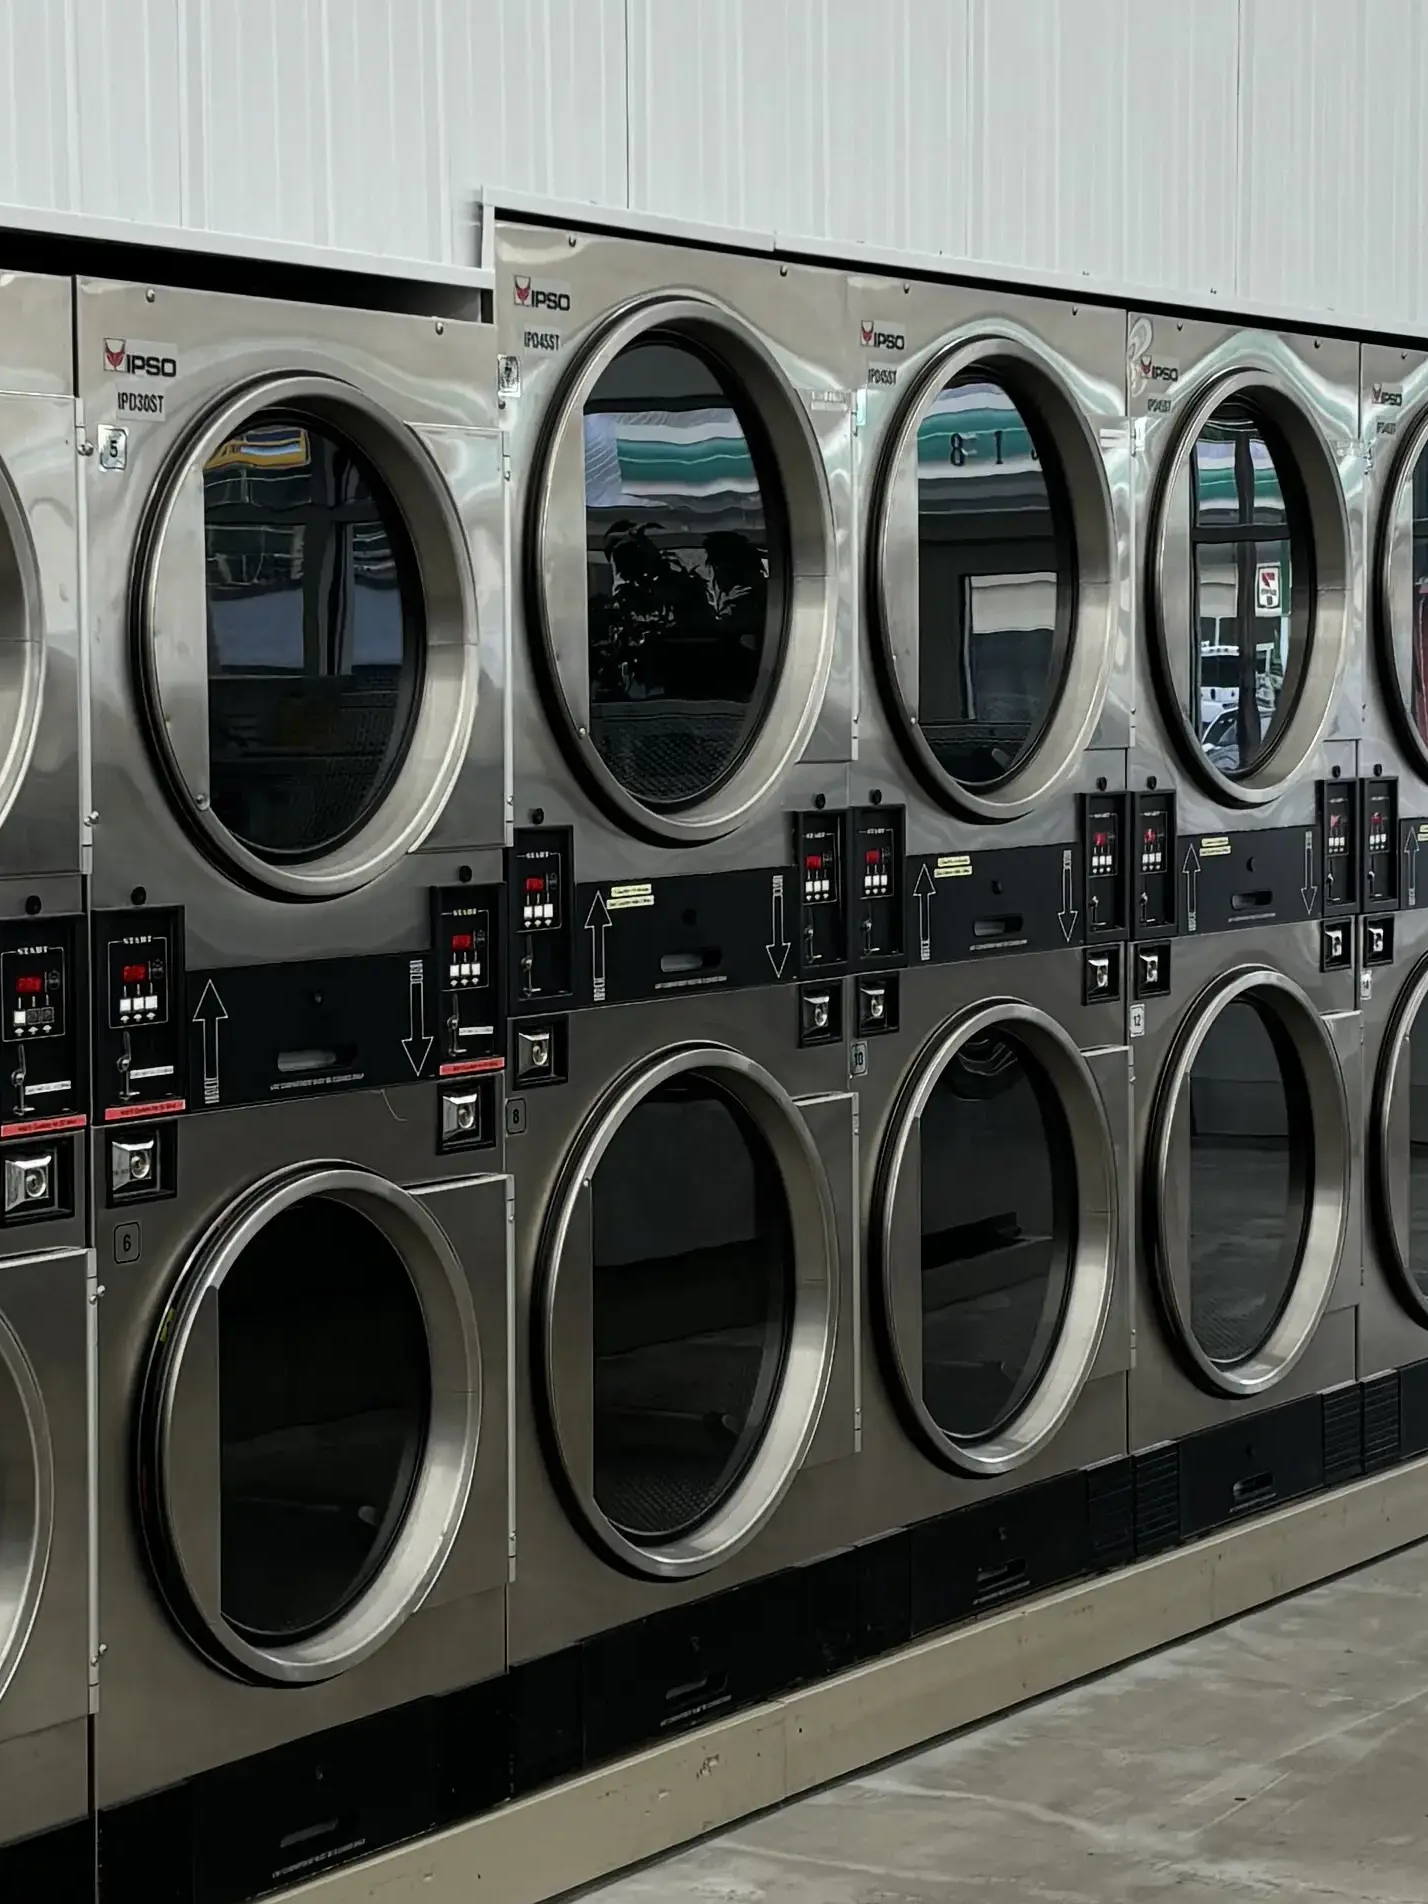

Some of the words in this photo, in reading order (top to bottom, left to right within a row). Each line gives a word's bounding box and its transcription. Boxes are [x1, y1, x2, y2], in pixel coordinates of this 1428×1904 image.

[531, 290, 570, 311] IPSO
[873, 332, 905, 350] IPSO
[125, 354, 177, 377] IPSO
[1152, 365, 1179, 383] IPSO
[118, 392, 164, 414] IPD30ST
[512, 1108, 519, 1124] 8
[123, 1234, 131, 1252] 6
